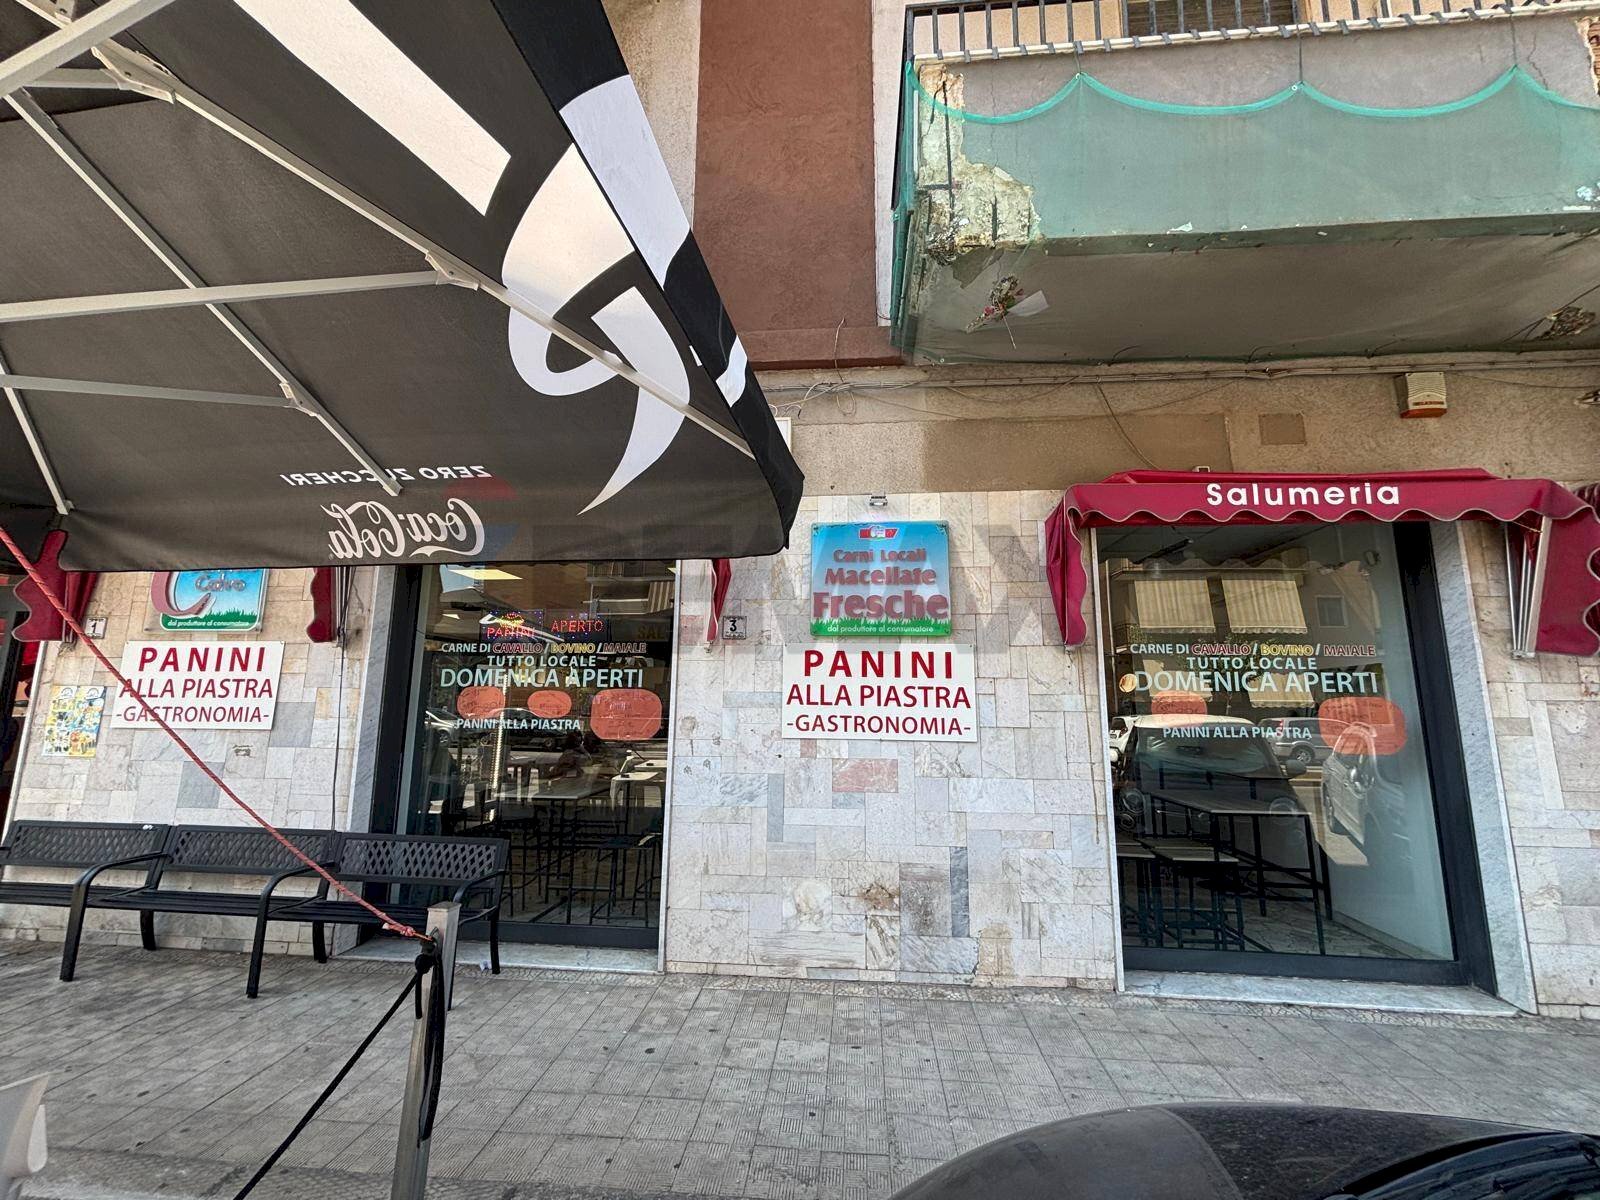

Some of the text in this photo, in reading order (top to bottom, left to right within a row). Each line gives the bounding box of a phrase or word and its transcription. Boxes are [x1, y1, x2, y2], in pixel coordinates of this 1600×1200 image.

[1207, 482, 1400, 506] Salumeria
[833, 548, 926, 563] Carni Locali
[824, 567, 936, 585] Macellate
[813, 590, 948, 619] Fresche
[551, 619, 604, 633] APERTO
[729, 619, 737, 632] 3
[827, 624, 839, 632] dal
[840, 625, 877, 635] produttore
[887, 625, 934, 633] consumatore
[441, 643, 477, 653] CARNE
[479, 643, 491, 653] DI
[493, 643, 544, 654] CAVALLO
[551, 643, 596, 654] BOVINO
[603, 643, 647, 654] MAIALE
[1130, 643, 1172, 654] CARNE
[1175, 643, 1189, 654] DI
[1191, 643, 1250, 655] CAVALLO
[1260, 644, 1314, 656] BOVINO
[1323, 644, 1376, 656] MAIALE
[138, 647, 266, 672] PANINI
[487, 655, 596, 667] TUTTO LOCALE
[804, 650, 953, 679] PANINI
[1187, 657, 1317, 669] TUTTO LOCALE
[440, 668, 643, 688] DOMENICA APERTI
[1136, 671, 1378, 693] DOMENICA APERTI
[119, 678, 175, 698] ALLA
[181, 678, 273, 698] PIASTRA
[786, 684, 971, 708] ALLA PIASTRA
[456, 719, 581, 730] PANINI ALLA PIASTRA
[787, 714, 971, 735] -GASTRONOMIA-
[1163, 726, 1312, 739] PANINI ALLA PIASTRA
